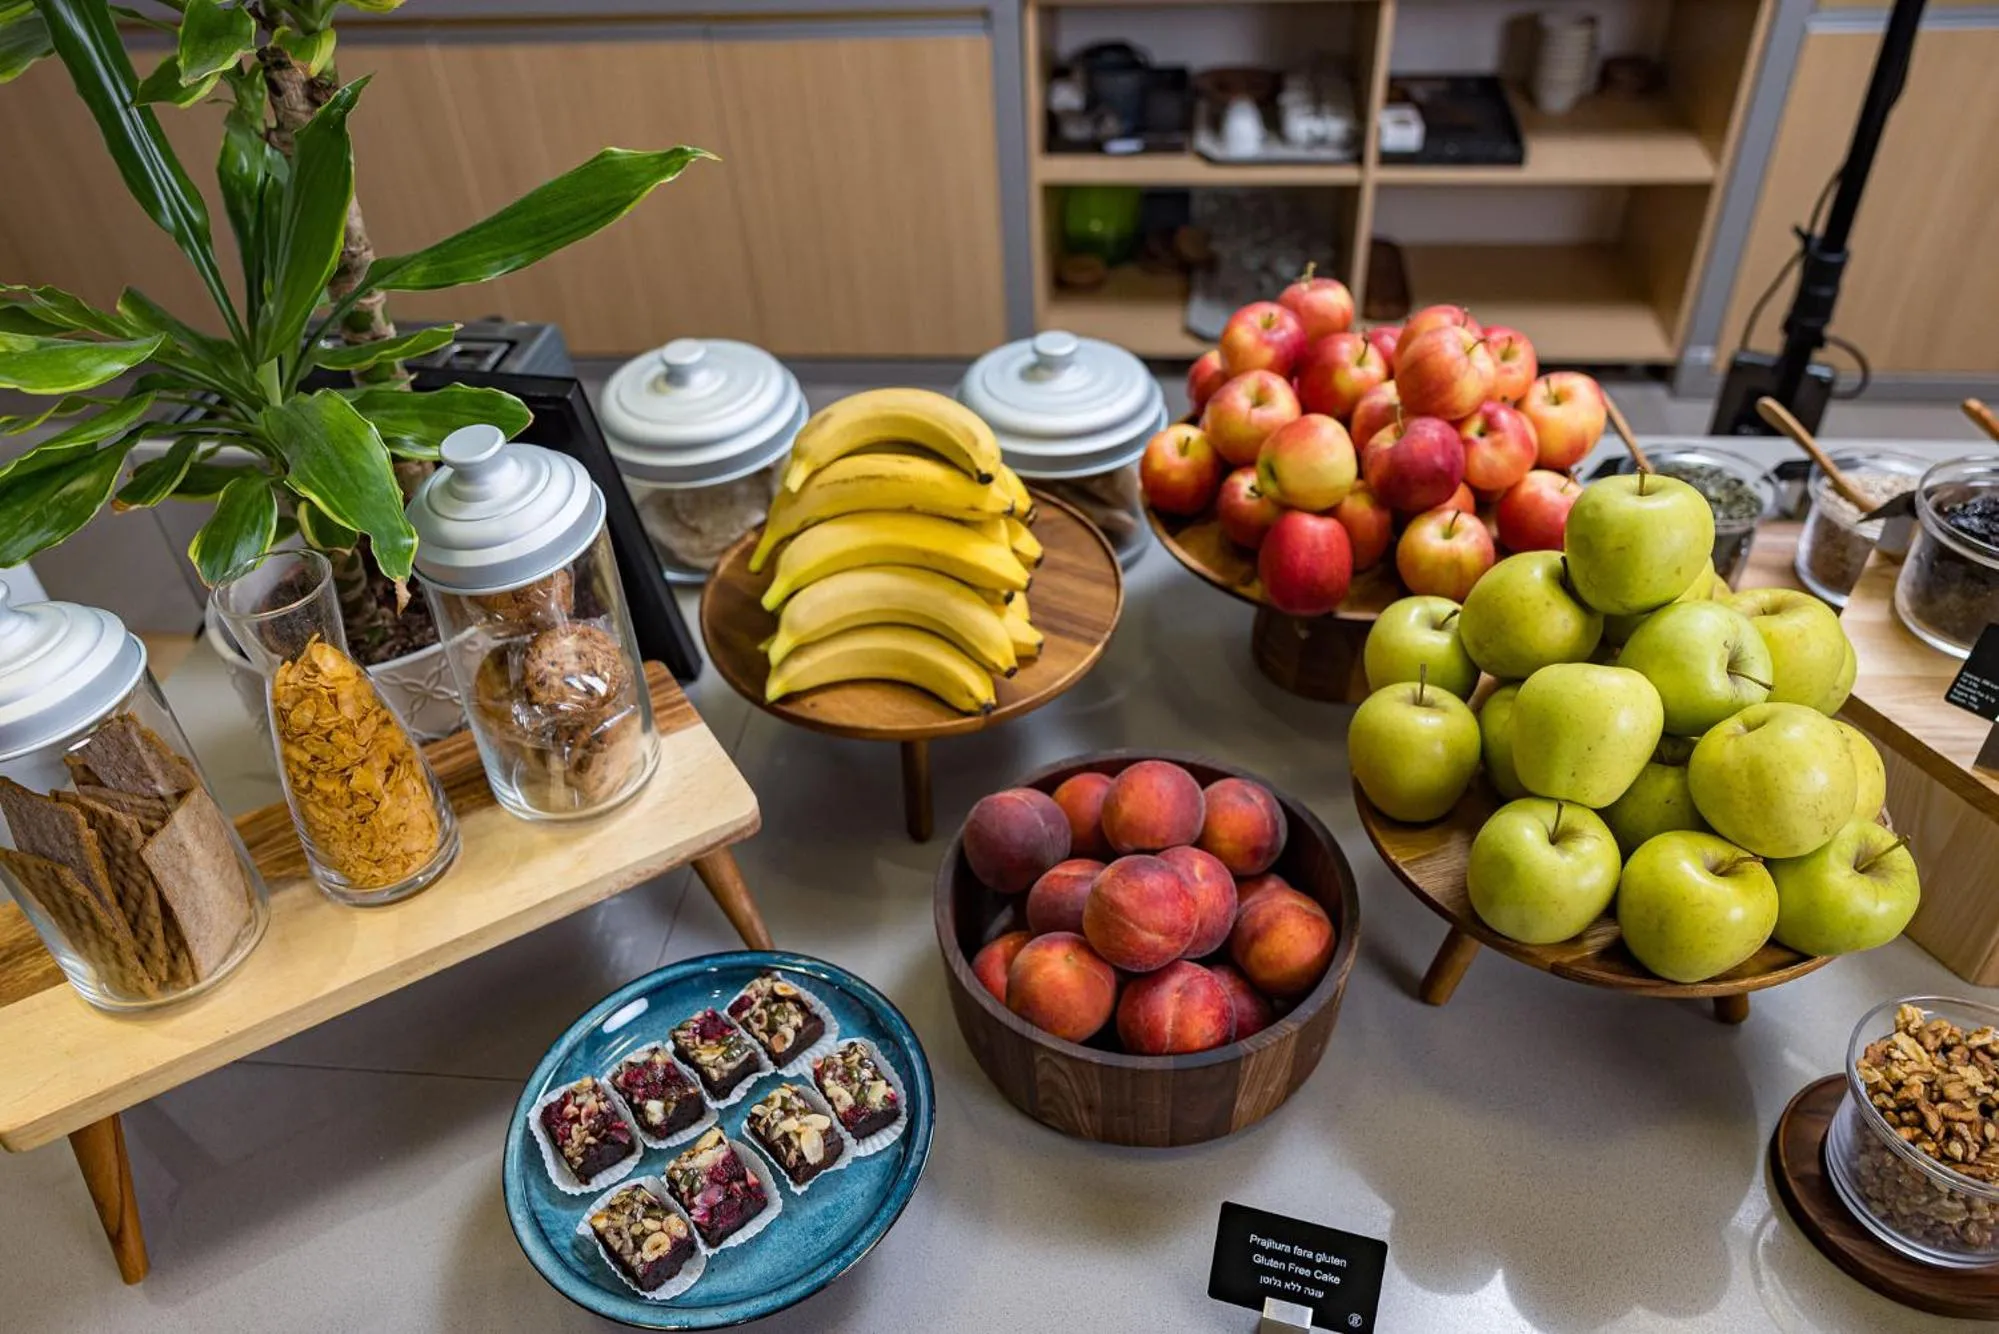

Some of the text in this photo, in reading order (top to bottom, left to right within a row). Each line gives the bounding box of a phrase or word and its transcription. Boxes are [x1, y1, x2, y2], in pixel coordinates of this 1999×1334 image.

[1249, 1233, 1347, 1268] Prajitura fara gluten
[1252, 1254, 1341, 1285] Gluten Free Cake
